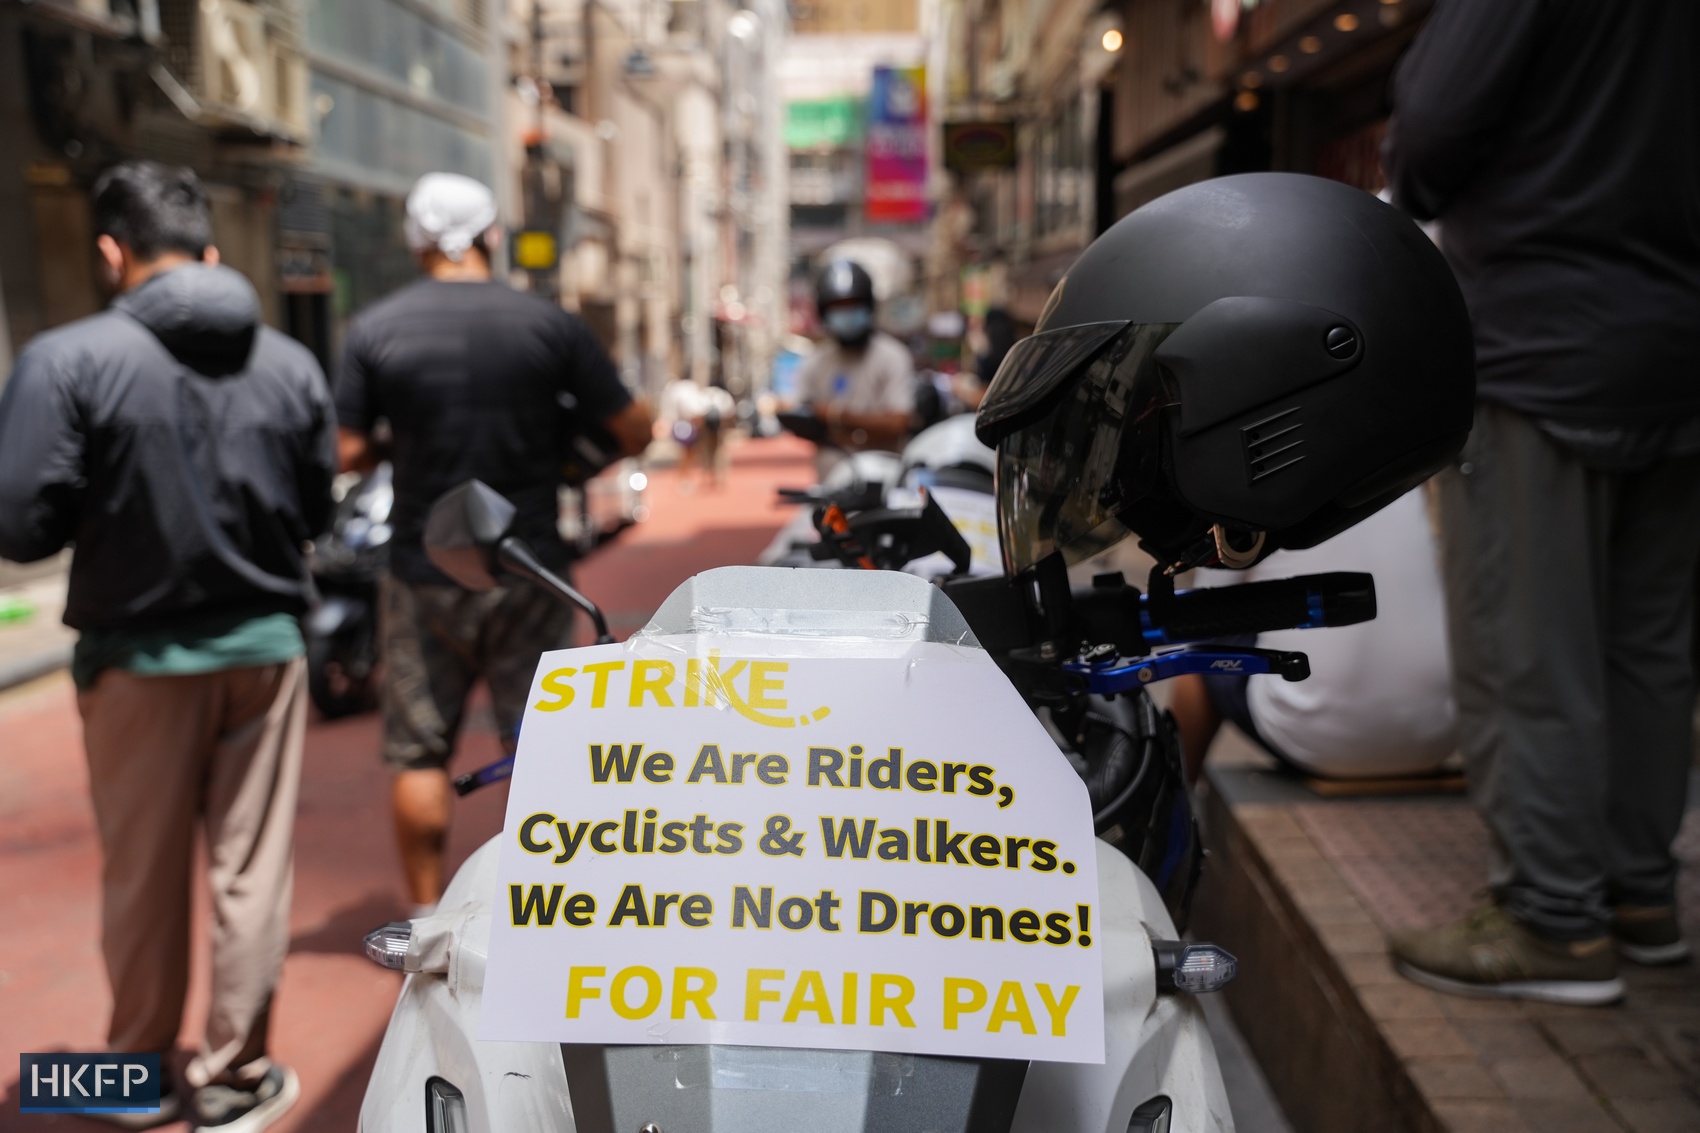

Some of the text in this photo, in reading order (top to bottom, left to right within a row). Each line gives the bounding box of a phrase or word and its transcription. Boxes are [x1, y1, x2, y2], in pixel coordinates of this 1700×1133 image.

[533, 648, 798, 728] STRIKE
[588, 742, 1016, 808] We Are Riders,
[517, 808, 1078, 875] Cyclists & Walkers.
[507, 883, 1093, 948] We Are Not Drones!
[564, 965, 1082, 1038] FOR FAIR PAY
